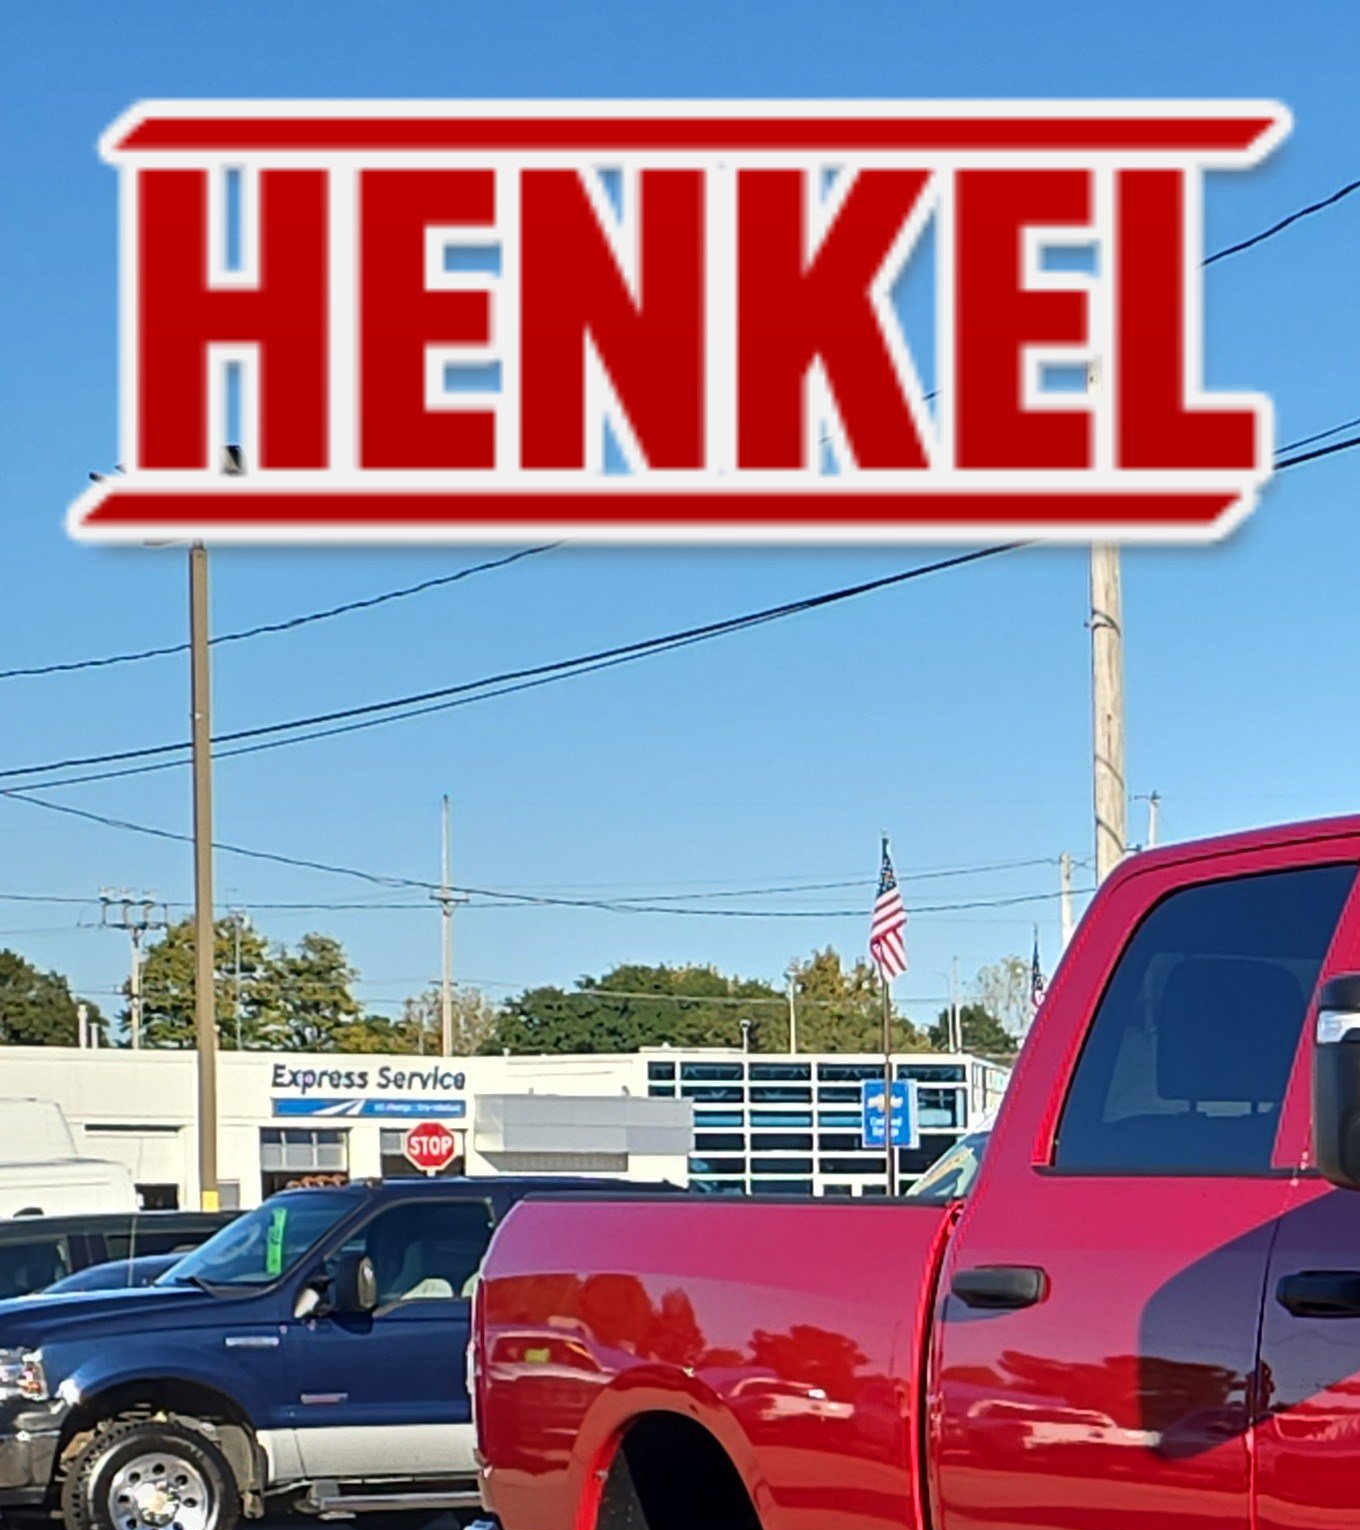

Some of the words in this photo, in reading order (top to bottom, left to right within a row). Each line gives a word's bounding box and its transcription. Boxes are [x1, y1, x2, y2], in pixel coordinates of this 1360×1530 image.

[271, 1063, 369, 1095] Express
[376, 1065, 466, 1091] Service
[409, 1135, 453, 1157] STOP
